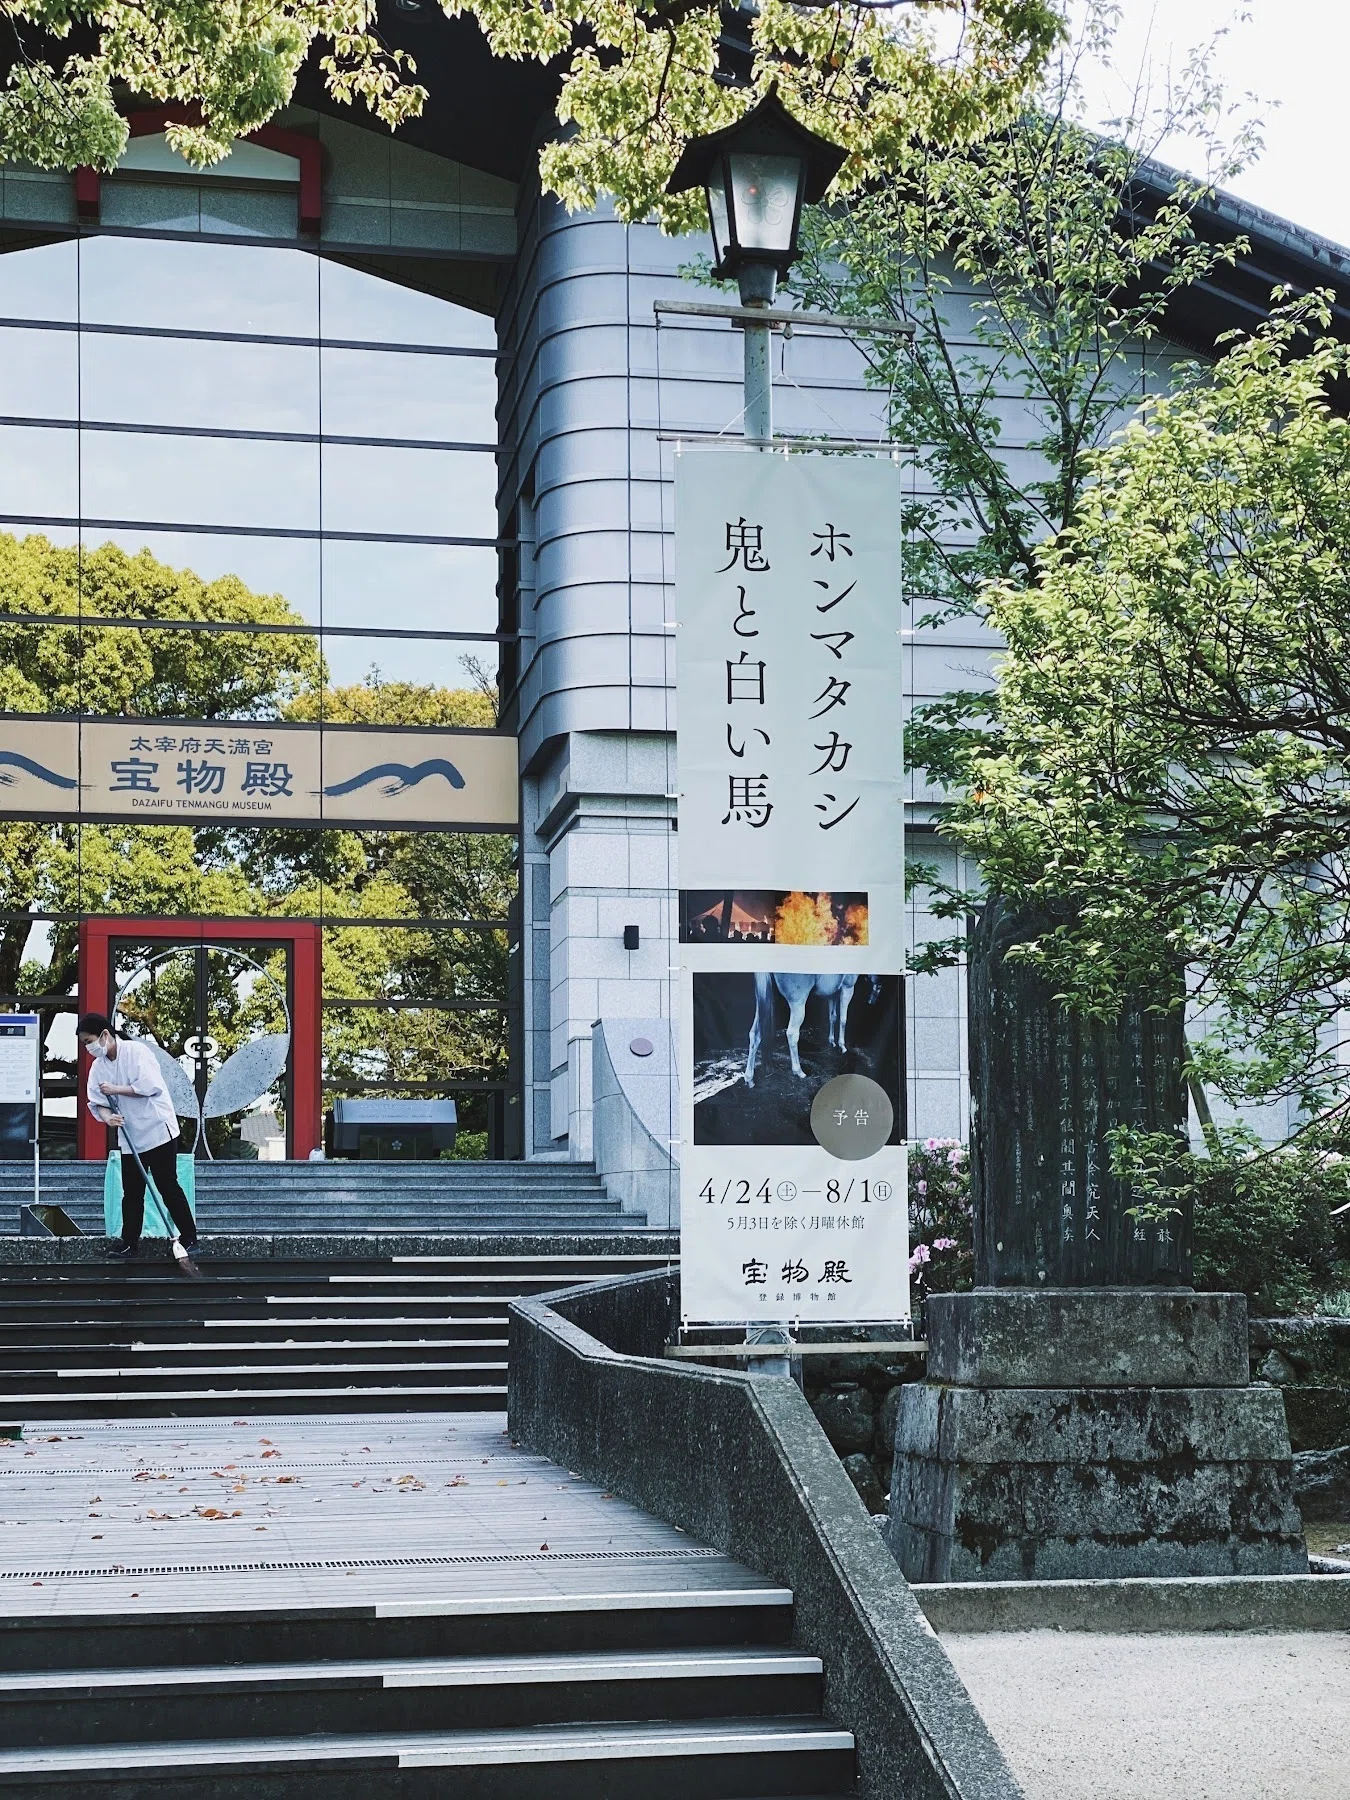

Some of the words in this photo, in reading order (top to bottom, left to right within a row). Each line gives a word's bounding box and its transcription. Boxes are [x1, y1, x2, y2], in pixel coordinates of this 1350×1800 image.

[714, 516, 774, 829] 鬼と白い馬
[808, 523, 861, 831] ホンマタカシ
[129, 735, 274, 756] 太宰府天満宮
[108, 757, 294, 797] 宝物殿
[131, 798, 173, 808] DAZAIFU
[175, 799, 229, 810] TENMANGU
[231, 801, 272, 811] MUSEUM
[833, 1108, 870, 1126] 予告
[727, 1214, 865, 1231] 5月3日を除く月曜休館
[741, 1257, 853, 1286] 宝物殿
[758, 1292, 837, 1302] 登録博物館
